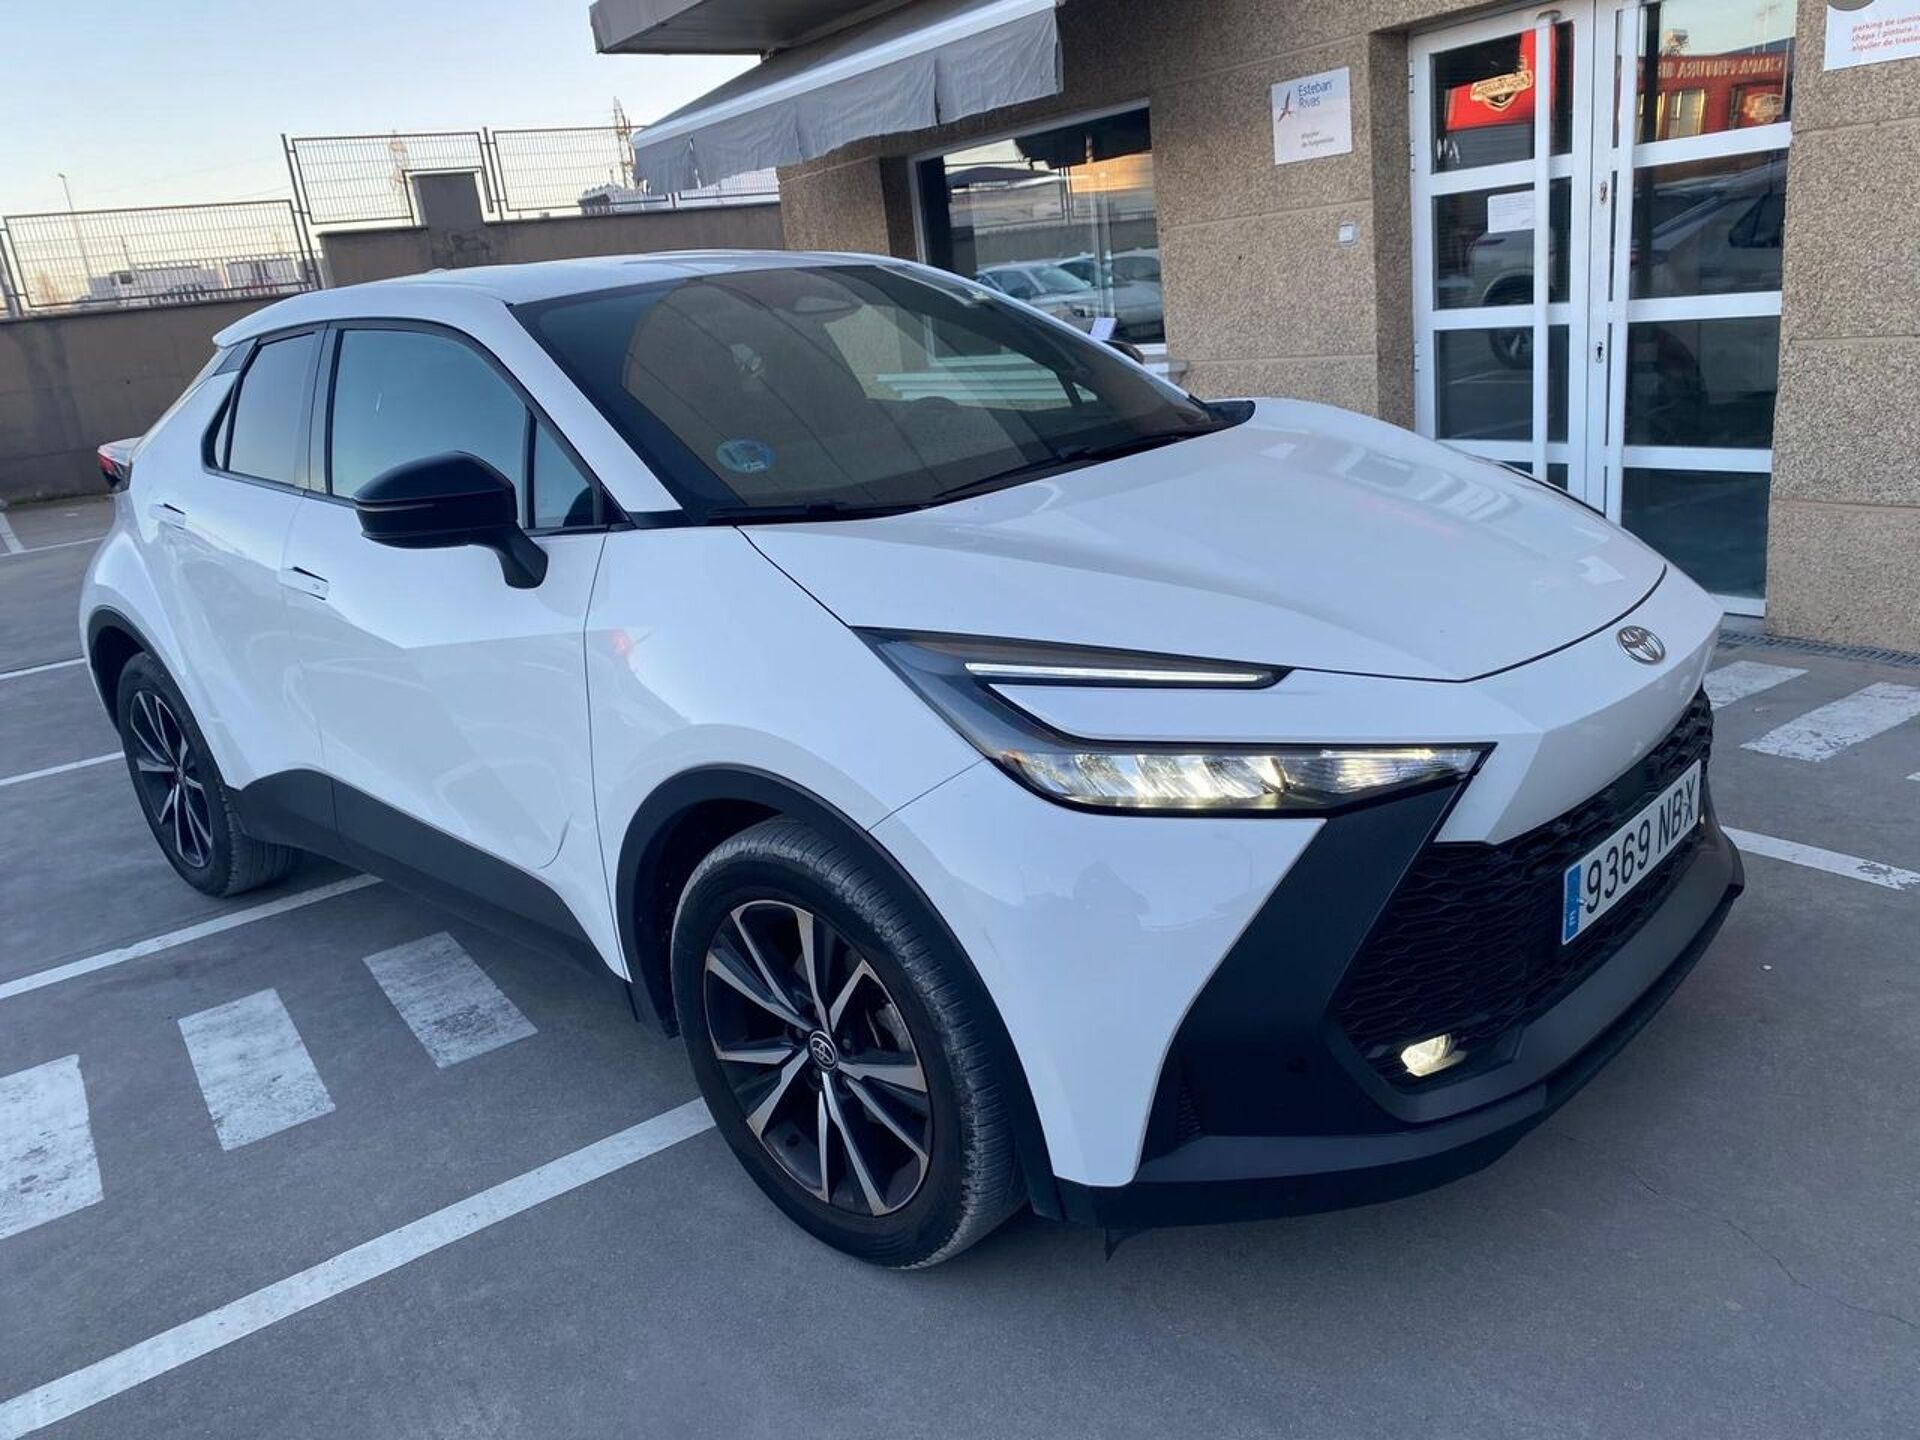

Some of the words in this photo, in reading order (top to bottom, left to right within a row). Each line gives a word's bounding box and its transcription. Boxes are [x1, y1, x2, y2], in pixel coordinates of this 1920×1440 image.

[1298, 81, 1332, 97] Esteban
[1299, 96, 1320, 108] Rivas
[1586, 818, 1651, 914] 9369
[1657, 774, 1696, 854] NBX
